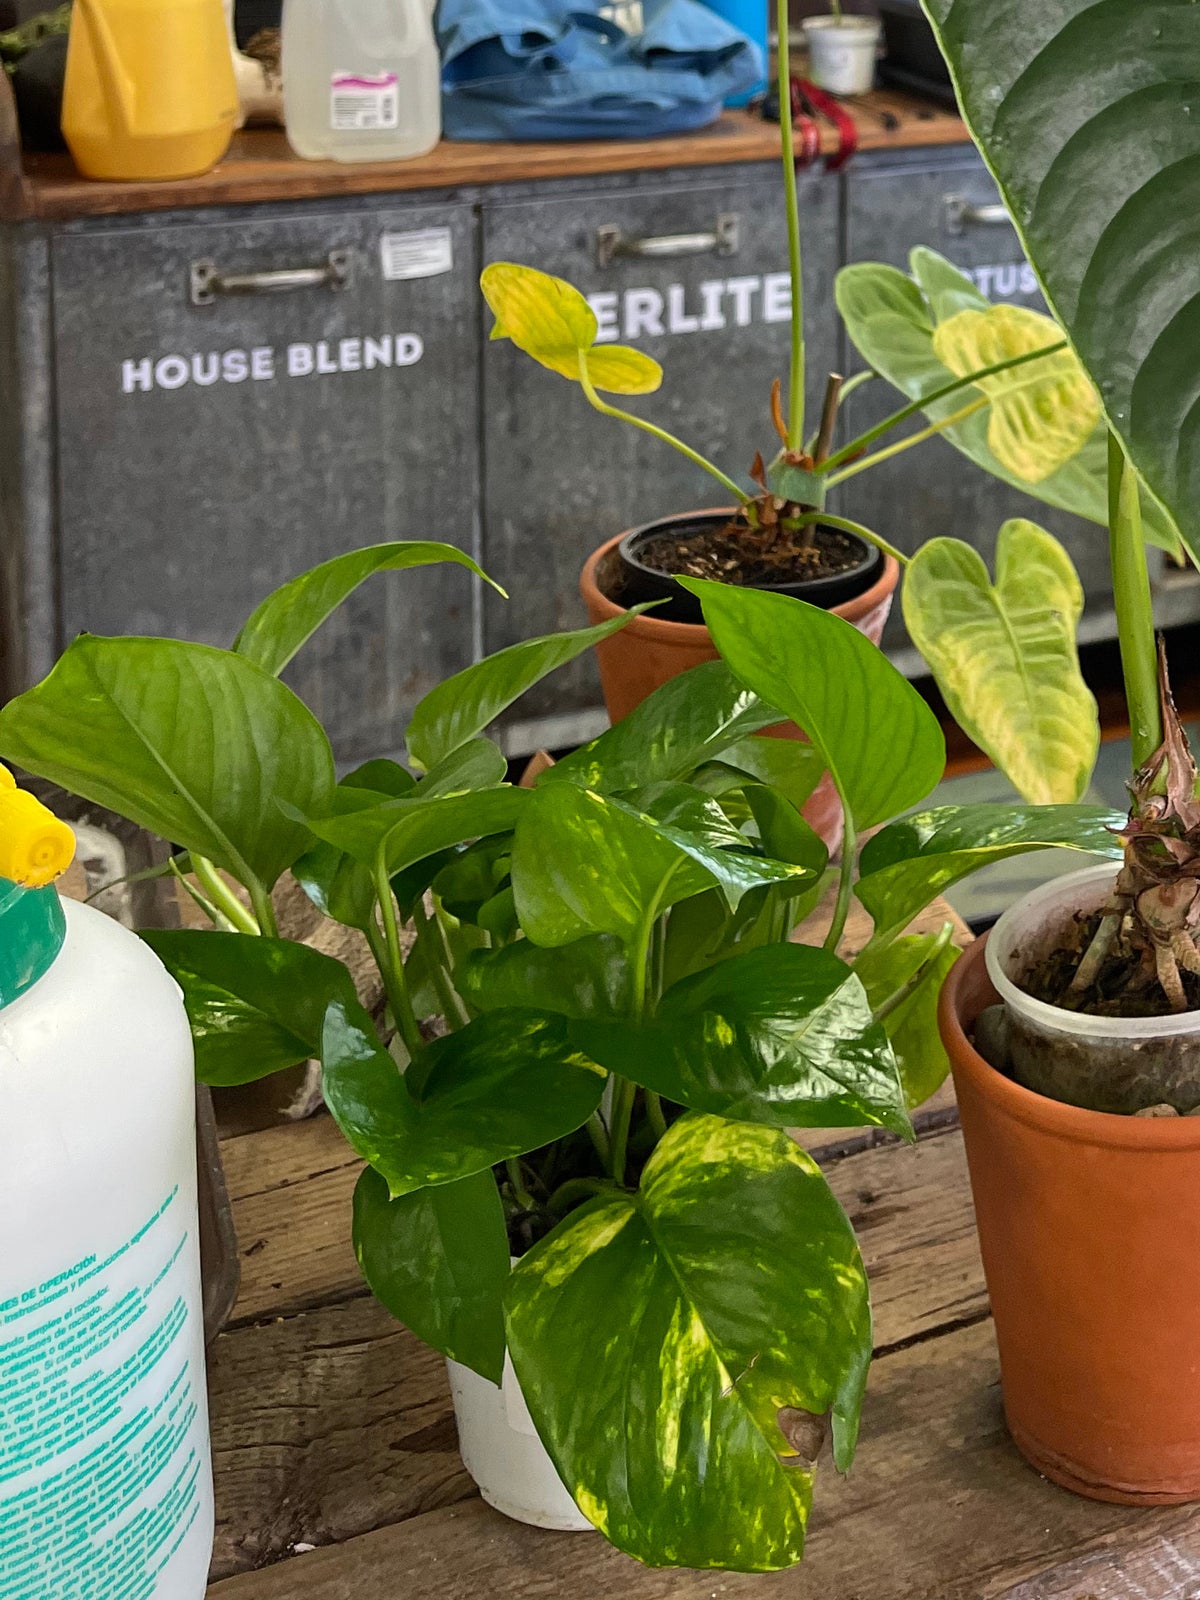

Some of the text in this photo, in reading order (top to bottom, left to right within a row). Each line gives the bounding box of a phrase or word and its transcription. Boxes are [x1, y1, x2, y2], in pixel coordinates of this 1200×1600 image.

[960, 261, 1039, 297] TUS
[121, 332, 424, 394] HOUSE BLEND
[21, 1288, 36, 1303] DE
